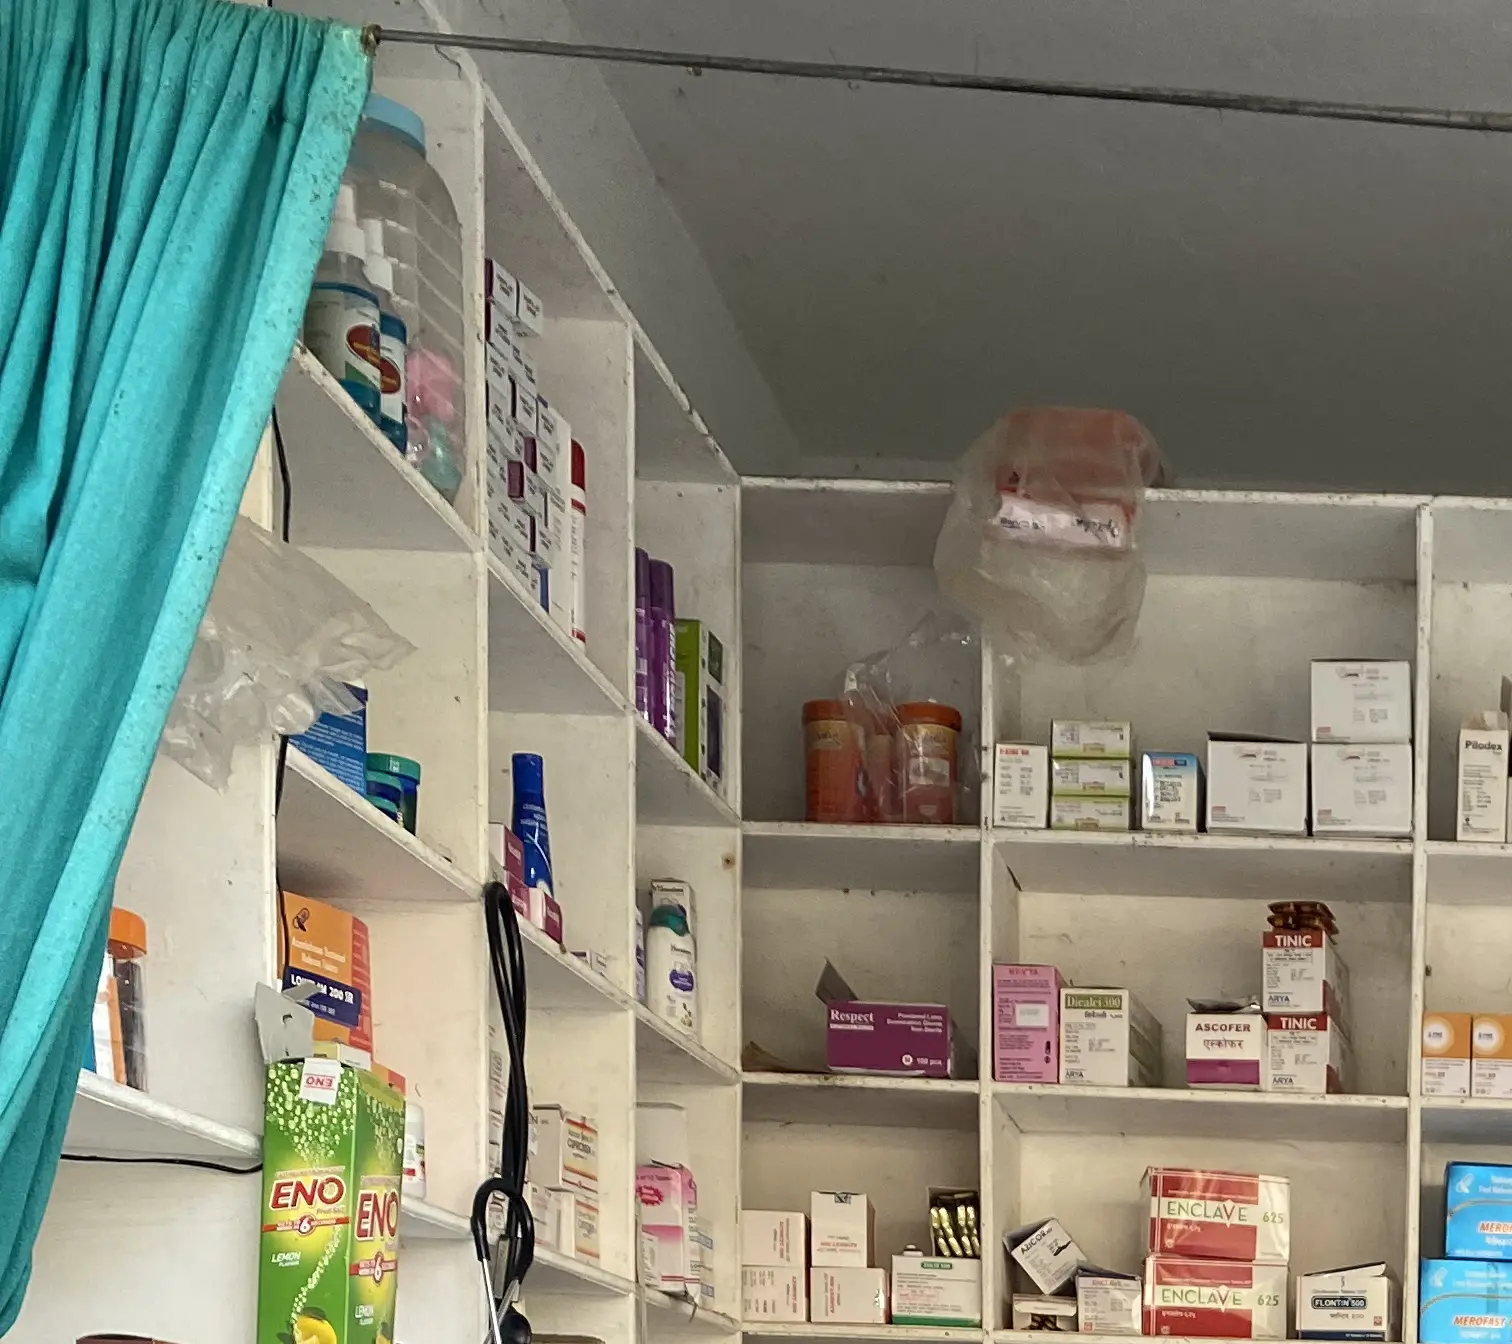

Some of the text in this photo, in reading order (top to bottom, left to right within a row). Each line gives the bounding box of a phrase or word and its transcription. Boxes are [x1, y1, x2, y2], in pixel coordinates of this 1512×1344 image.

[1275, 934, 1312, 947] TINIC
[830, 1009, 874, 1023] Respect
[1195, 1022, 1251, 1032] ASCOFER
[1280, 1017, 1317, 1030] TINIC
[306, 1076, 333, 1088] ENO
[271, 1176, 345, 1209] ENO
[356, 1191, 398, 1238] ENO
[1168, 1200, 1284, 1228] ENCLAVE 625
[272, 1253, 300, 1263] LEMON
[1161, 1285, 1279, 1312] ENCLAVE 625
[1314, 1298, 1348, 1308] FLONTIN
